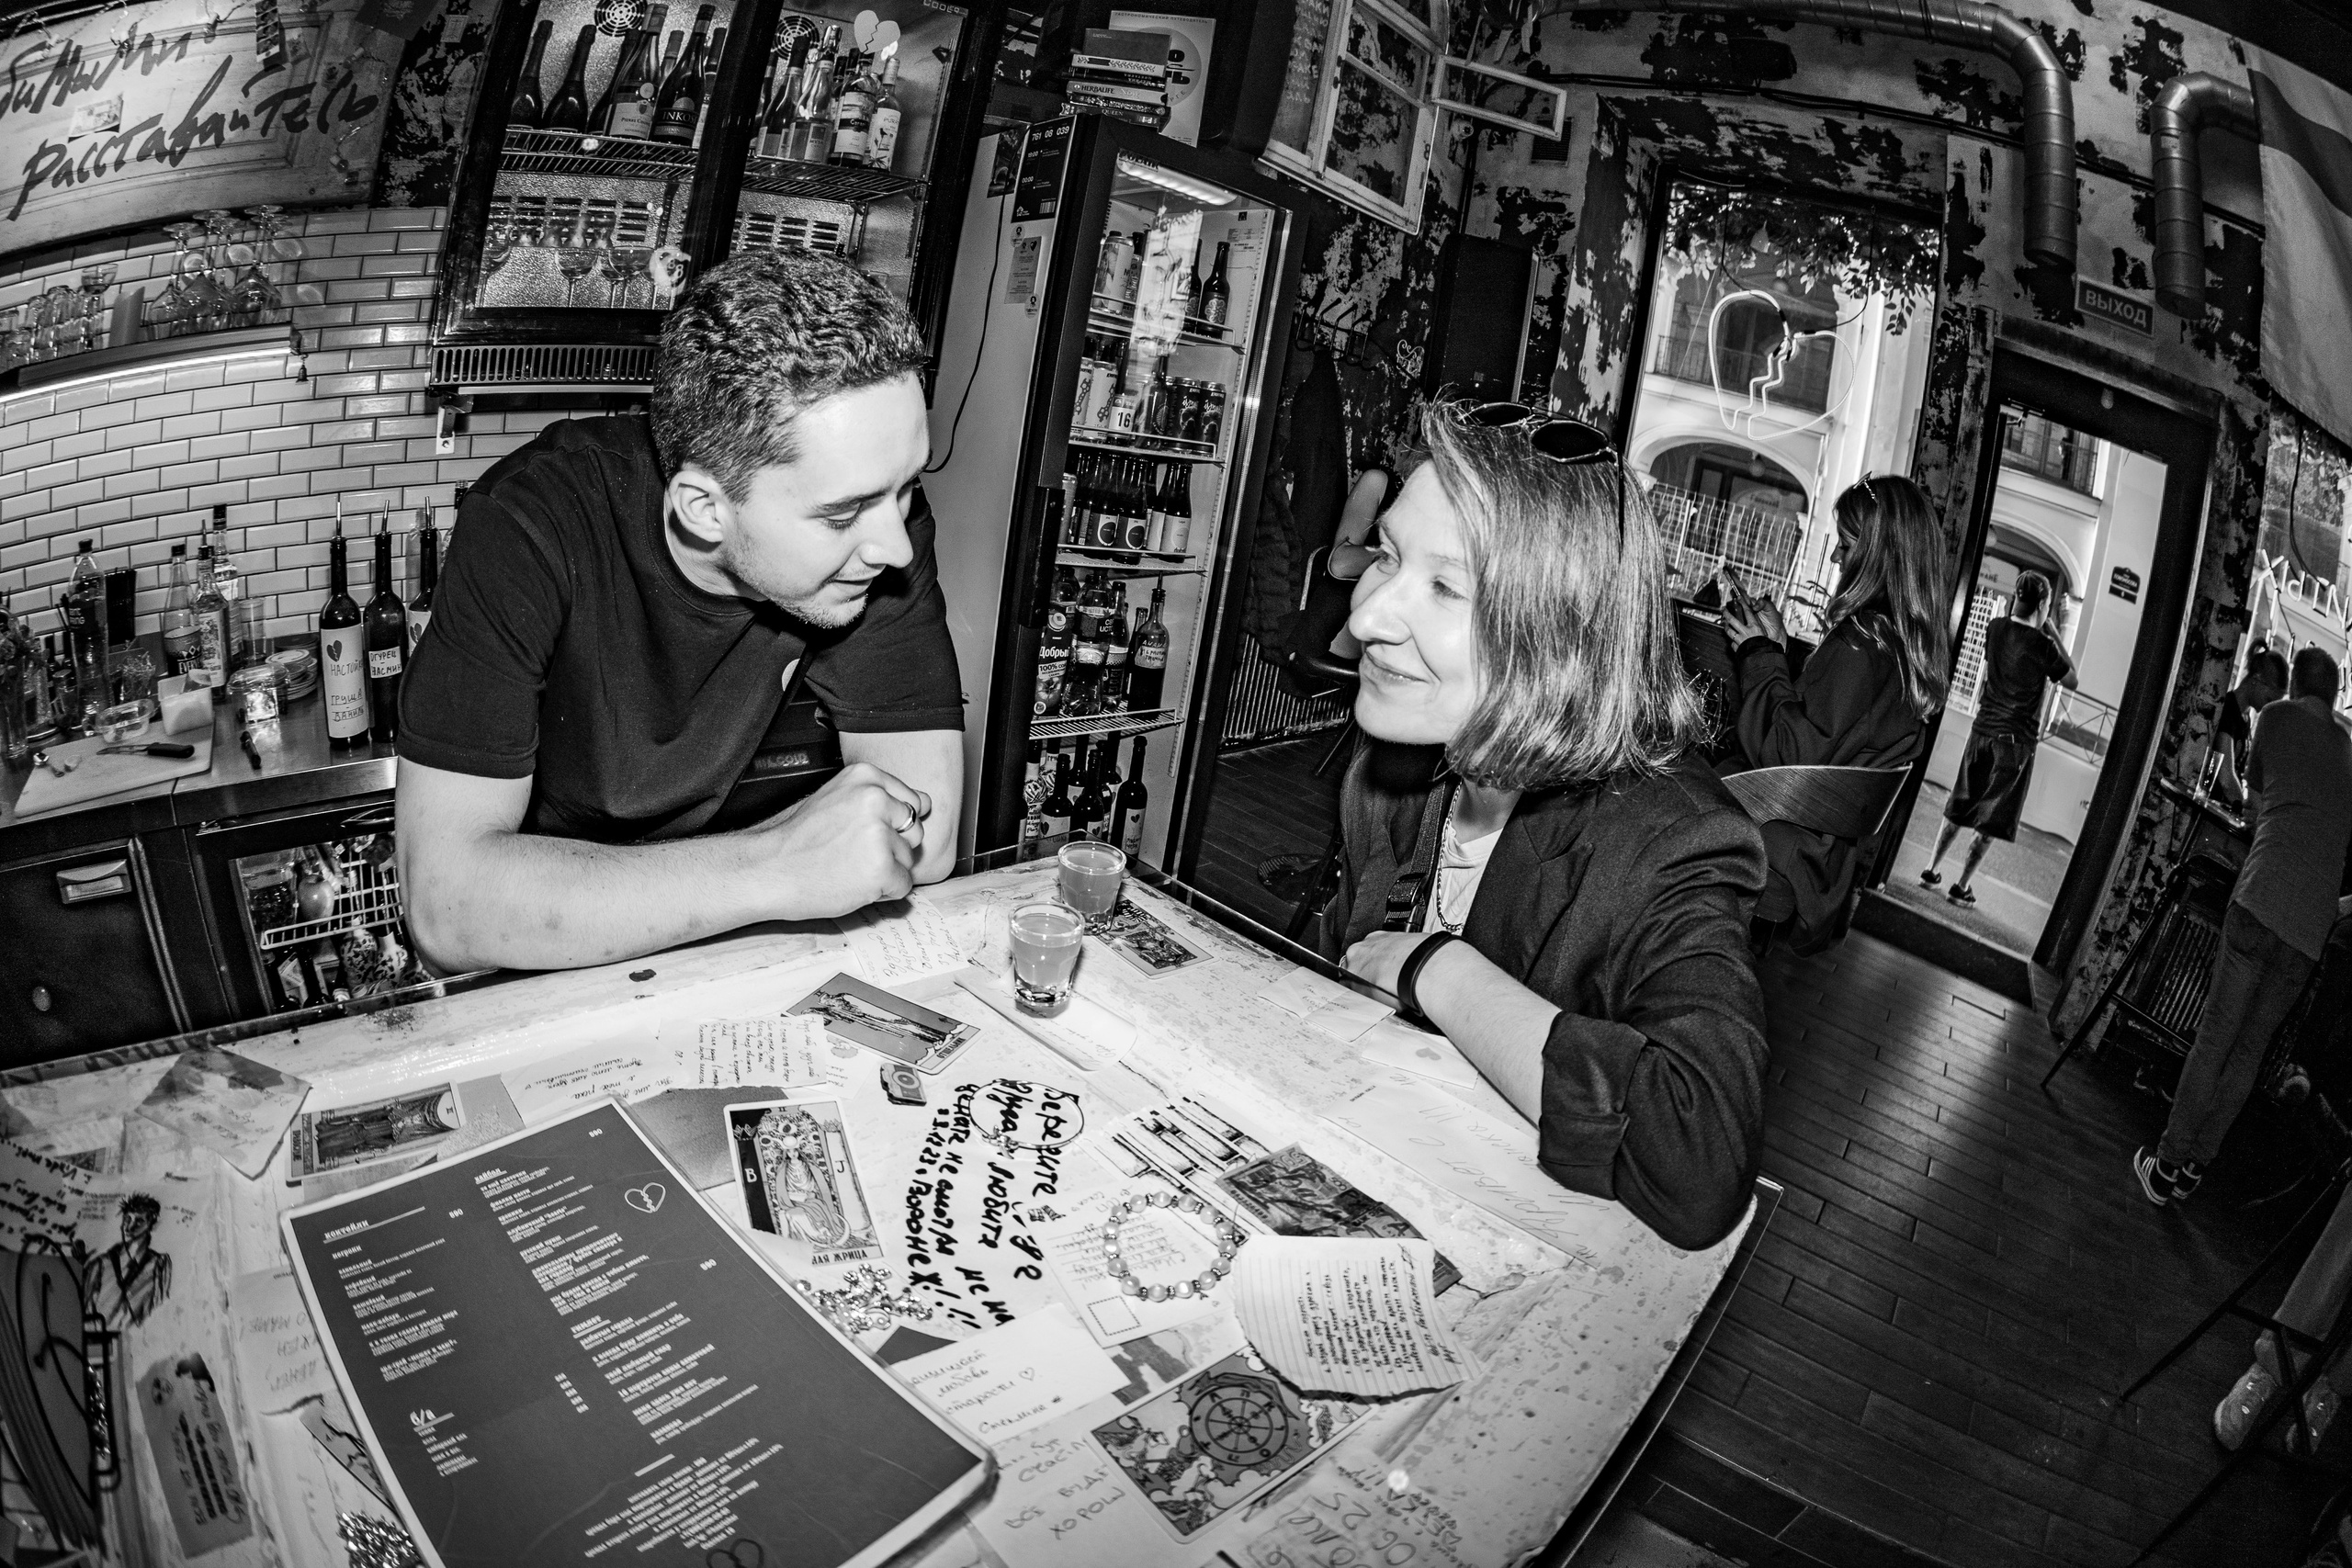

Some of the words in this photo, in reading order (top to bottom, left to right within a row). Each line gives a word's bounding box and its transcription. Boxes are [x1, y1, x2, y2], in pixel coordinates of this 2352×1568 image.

[1080, 85, 1114, 94] HERBALIFE
[2086, 289, 2146, 328] ВЫХОД
[1118, 412, 1131, 428] 16
[323, 1217, 369, 1240] коктейли
[331, 1244, 363, 1262] негрони
[833, 1249, 868, 1263] ЖРИЦА
